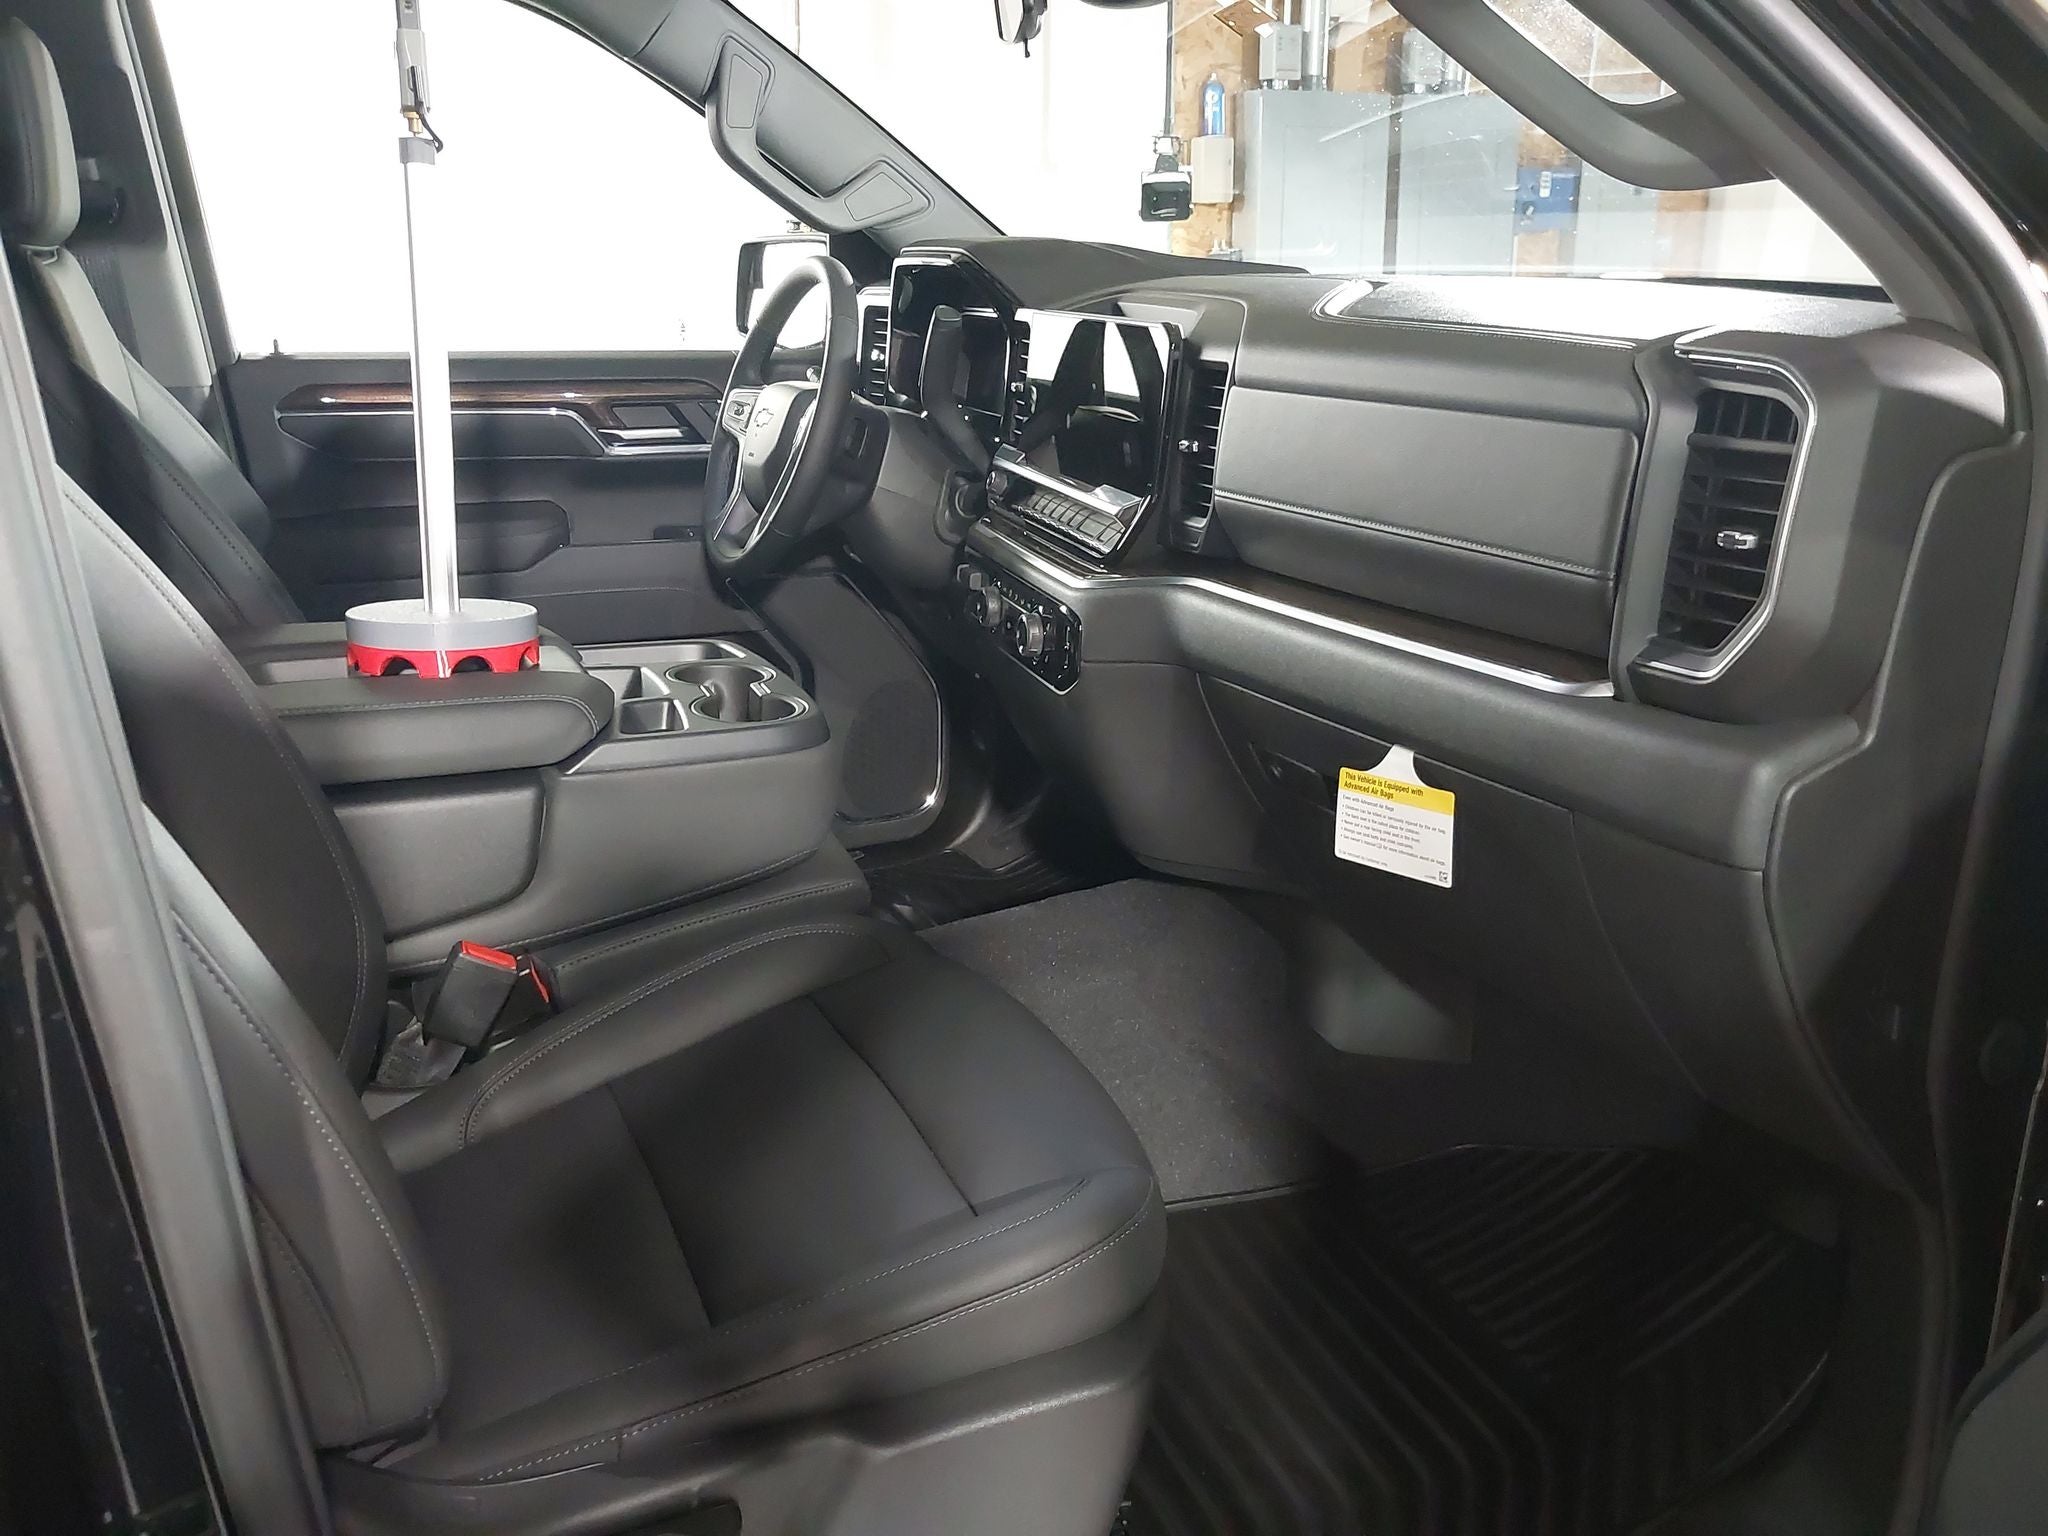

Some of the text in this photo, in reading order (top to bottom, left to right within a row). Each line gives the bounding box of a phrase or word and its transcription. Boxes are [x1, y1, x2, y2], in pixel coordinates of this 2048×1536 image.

[1344, 781, 1369, 793] Advanced
[1380, 789, 1394, 800] Bags
[1346, 772, 1355, 780] This
[1358, 774, 1376, 785] Vehicle
[1384, 780, 1409, 794] Equipped
[1411, 788, 1424, 796] with
